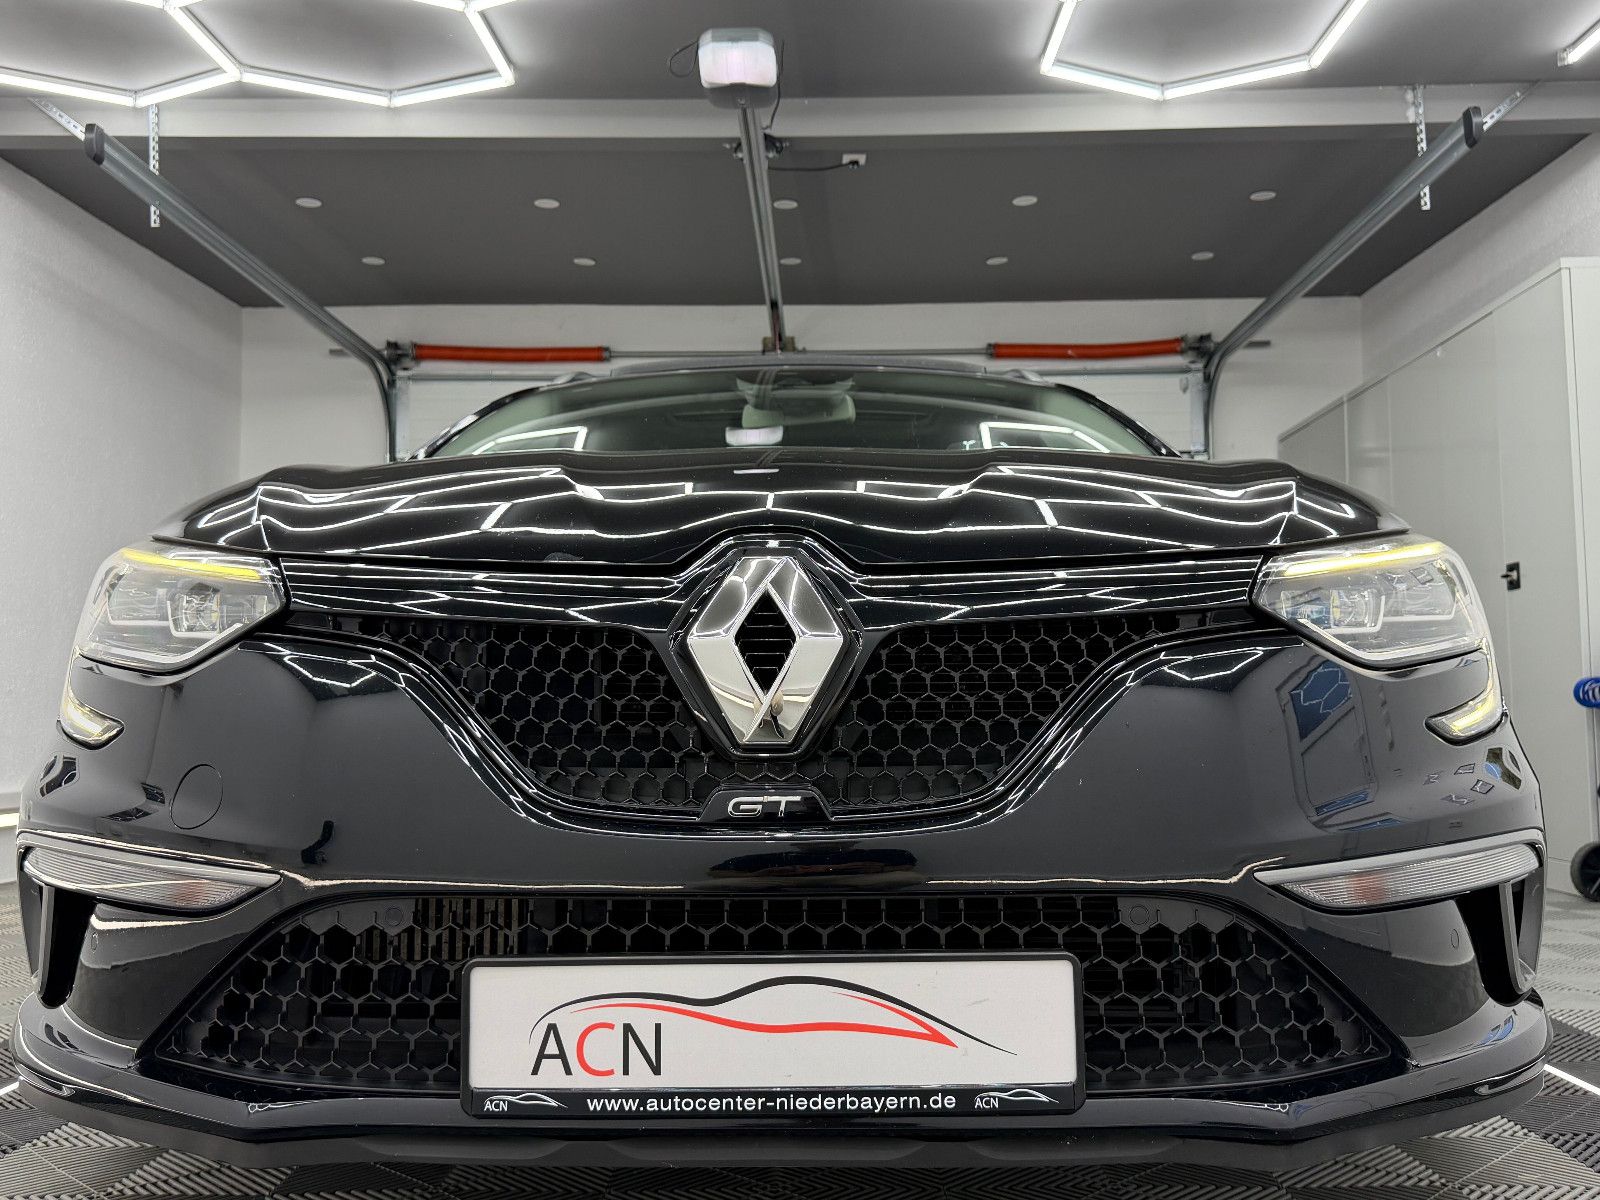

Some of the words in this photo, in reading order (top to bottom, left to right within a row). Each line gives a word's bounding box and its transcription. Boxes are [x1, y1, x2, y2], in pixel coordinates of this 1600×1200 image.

[727, 795, 802, 818] GT
[530, 1021, 662, 1077] ACN
[483, 1100, 508, 1112] ACN
[586, 1093, 957, 1114] www.autocenter-niederbayern.de
[974, 1097, 999, 1109] ACN
